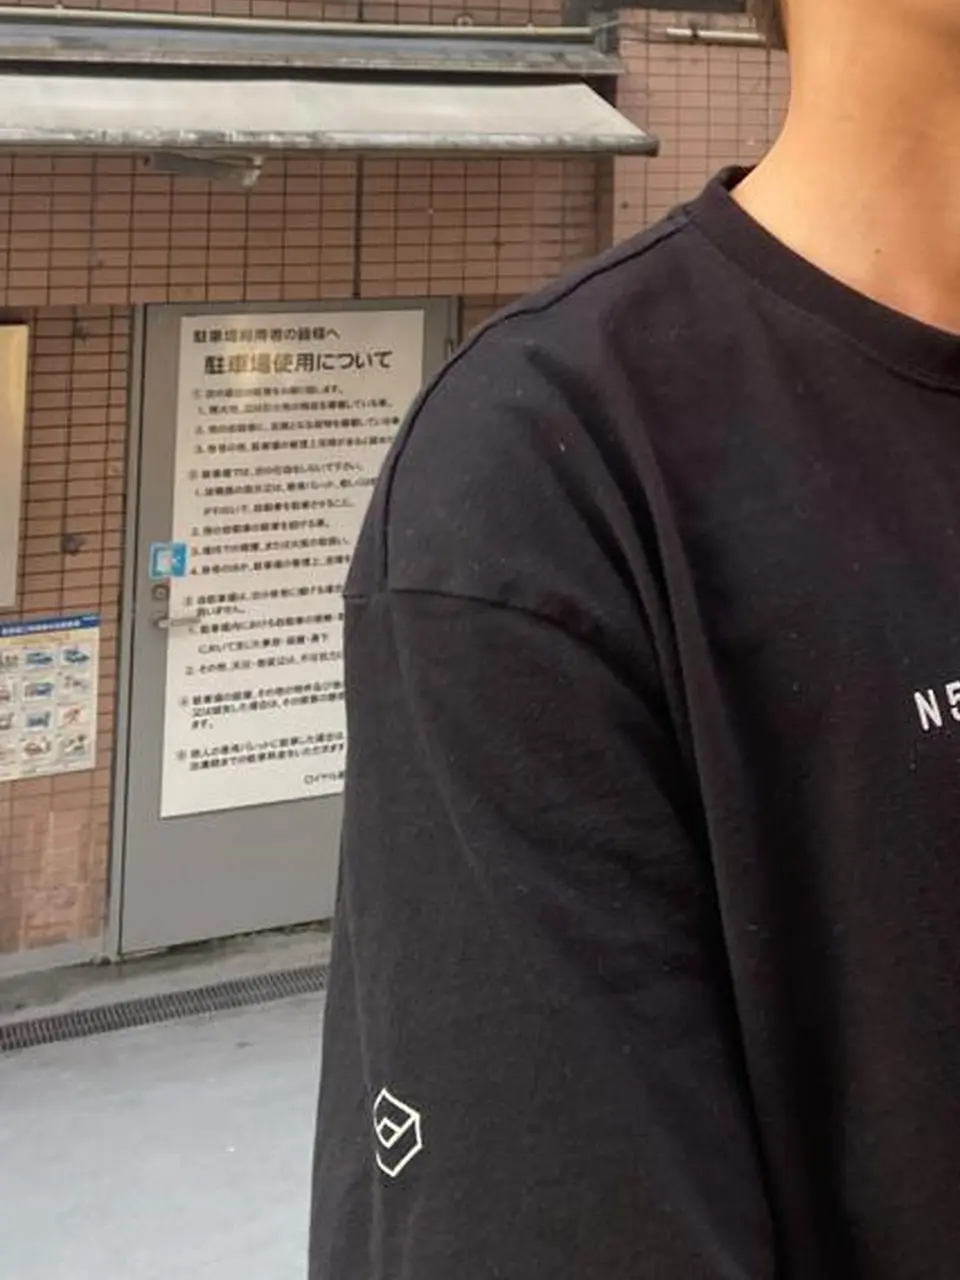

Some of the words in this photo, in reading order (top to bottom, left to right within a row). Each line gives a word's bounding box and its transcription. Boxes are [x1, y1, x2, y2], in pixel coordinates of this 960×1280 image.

[204, 351, 392, 375] 駐車場使用について
[913, 688, 943, 730] N
